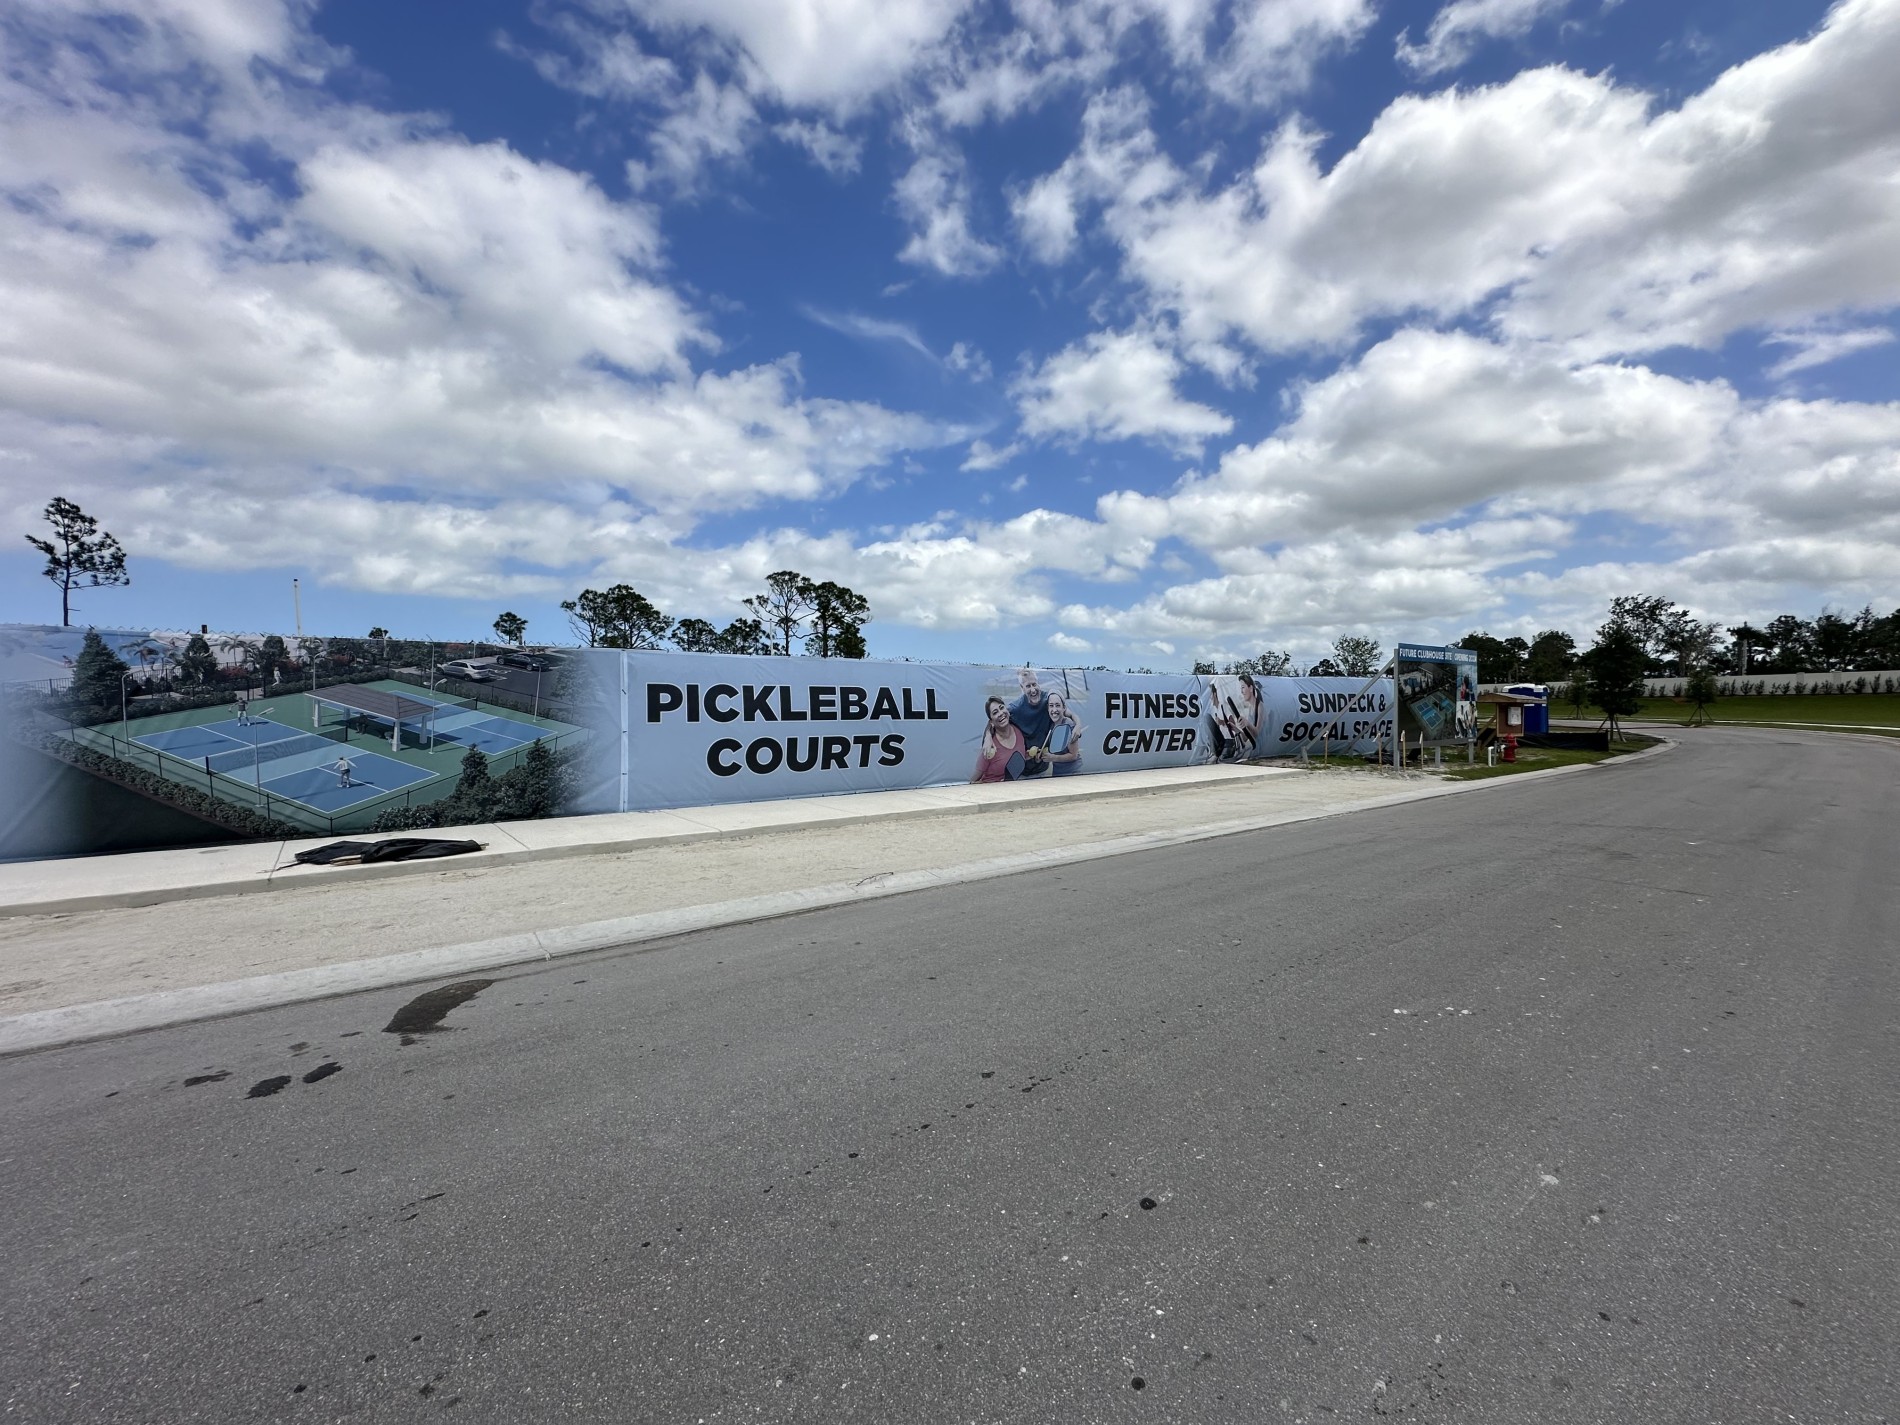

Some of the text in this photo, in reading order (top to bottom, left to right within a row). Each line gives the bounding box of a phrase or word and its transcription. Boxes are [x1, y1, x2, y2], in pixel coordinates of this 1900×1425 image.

[1399, 648, 1417, 658] FUTURE
[1417, 649, 1445, 660] CLUBHOUSE
[646, 683, 949, 723] PICKLEBALL
[1105, 692, 1200, 719] FITNESS
[1299, 693, 1386, 713] SUNDECK &
[1103, 728, 1195, 755] CENTER
[1353, 720, 1393, 741] SPACE
[706, 734, 906, 776] COURTS
